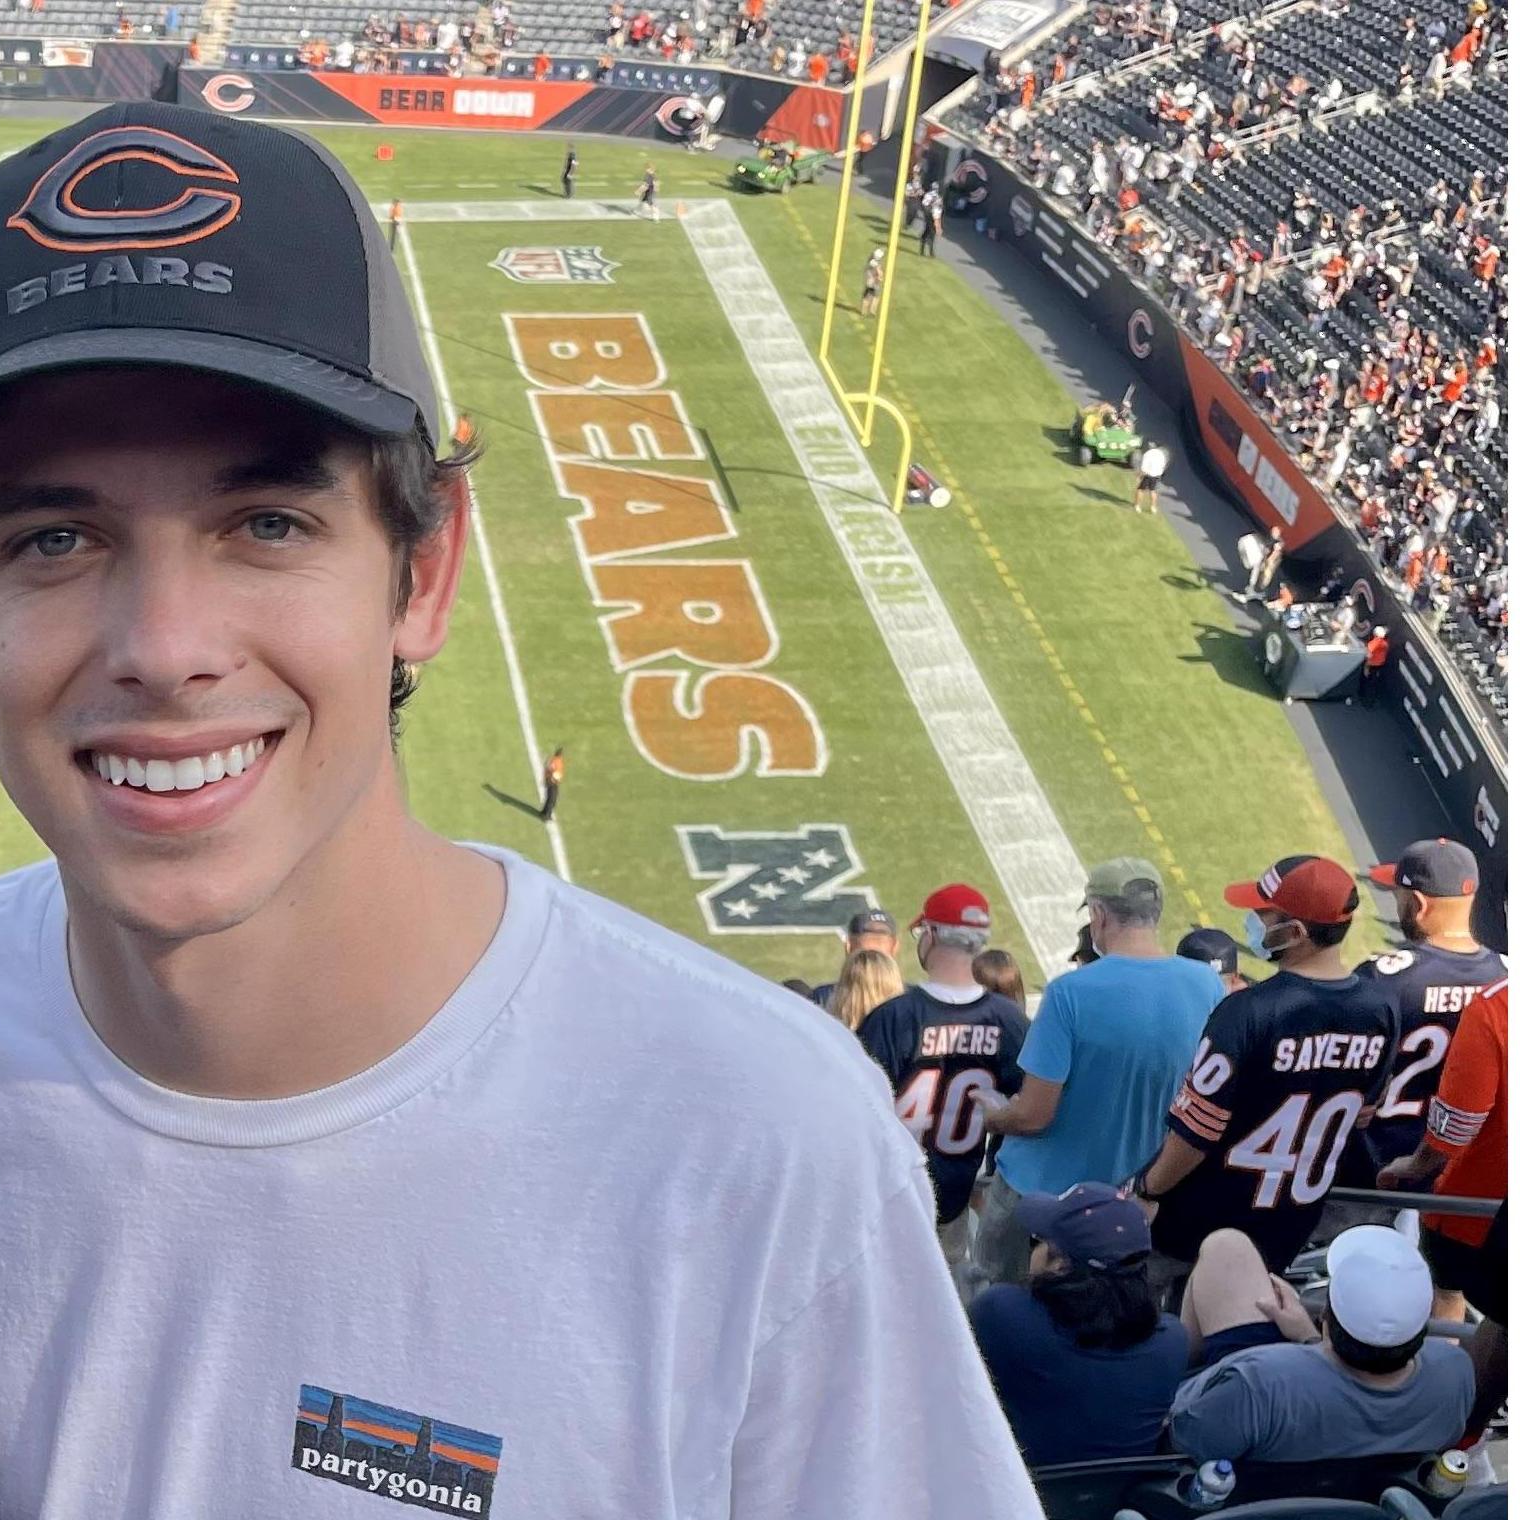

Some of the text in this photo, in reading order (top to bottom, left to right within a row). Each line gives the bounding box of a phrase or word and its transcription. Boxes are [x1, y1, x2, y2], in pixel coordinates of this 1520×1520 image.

[378, 88, 445, 111] BEAR
[7, 255, 235, 314] BEARS
[501, 312, 829, 780] BEARS
[1424, 986, 1482, 1013] HEST
[921, 1025, 1001, 1057] SAYERS
[1273, 1033, 1385, 1073] SAYERS
[895, 1068, 995, 1156] 40
[1227, 1089, 1365, 1209] 40
[300, 1447, 482, 1513] partygonia
